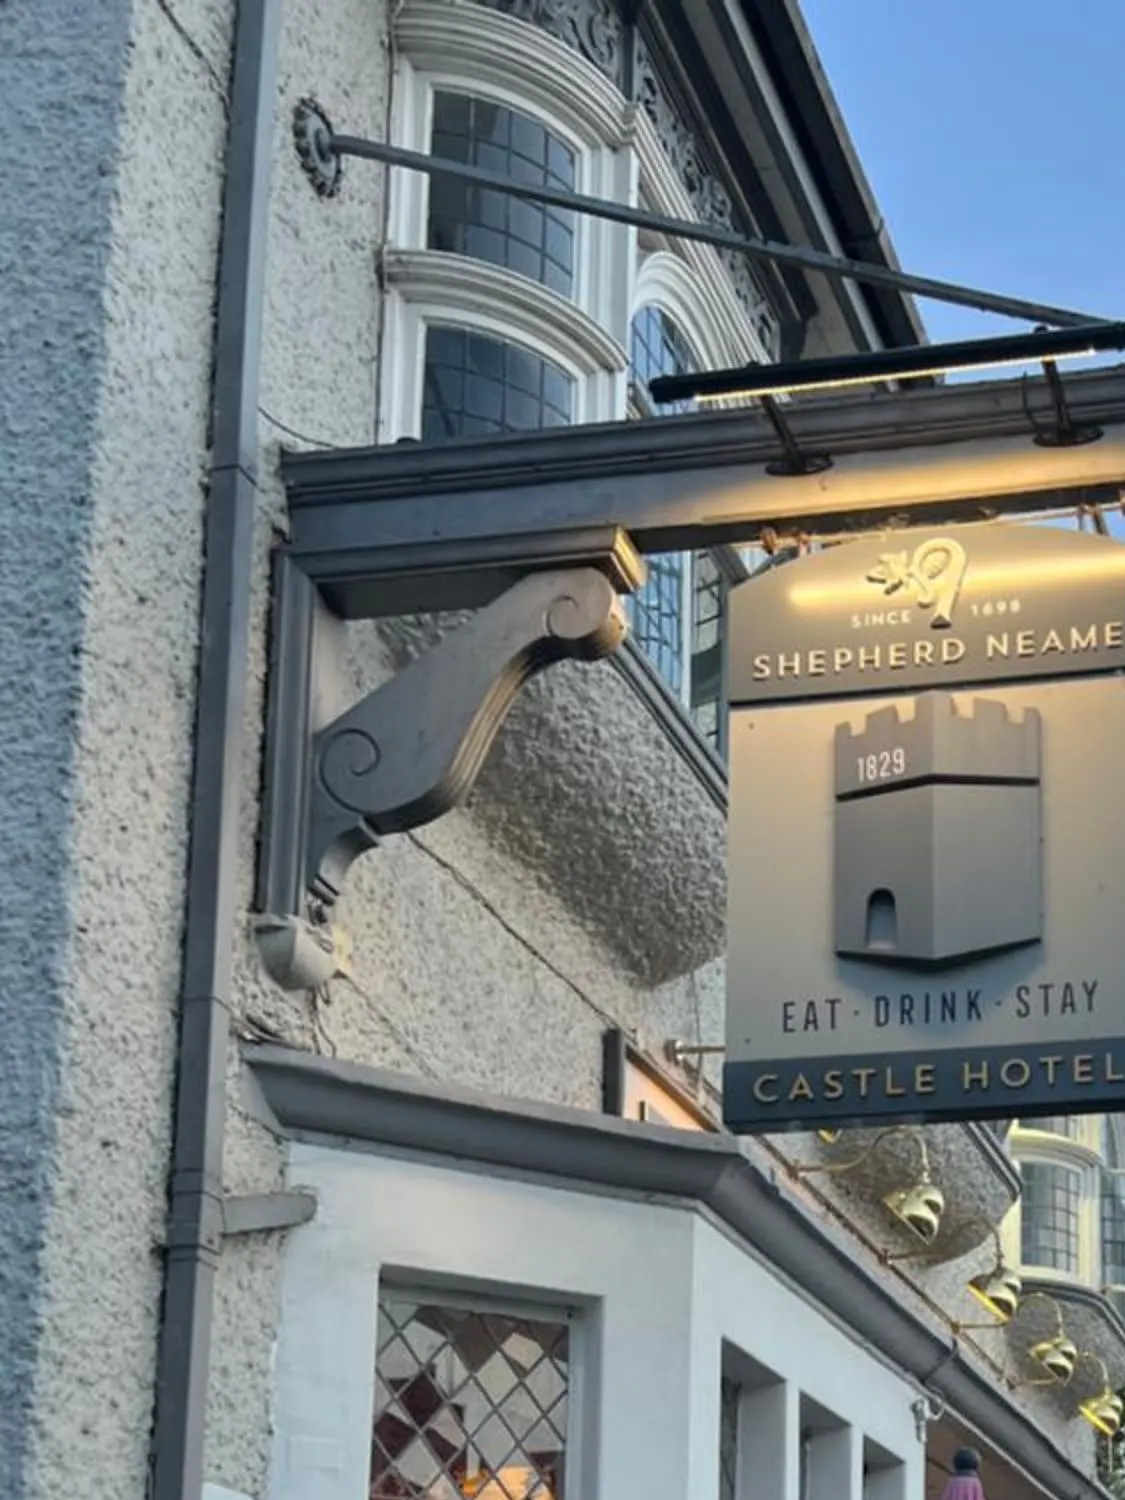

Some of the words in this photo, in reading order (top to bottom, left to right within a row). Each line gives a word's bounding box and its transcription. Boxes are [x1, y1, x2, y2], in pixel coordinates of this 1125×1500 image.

[851, 609, 911, 628] SINCE
[752, 638, 966, 681] SHEPHERD
[986, 622, 1125, 659] NEAME
[857, 748, 905, 782] 1829
[783, 999, 841, 1033] EAT
[874, 988, 983, 1028] DRINK
[1015, 980, 1099, 1018] STAY
[753, 1063, 936, 1102] CASTLE
[963, 1053, 1125, 1091] HOTEL
